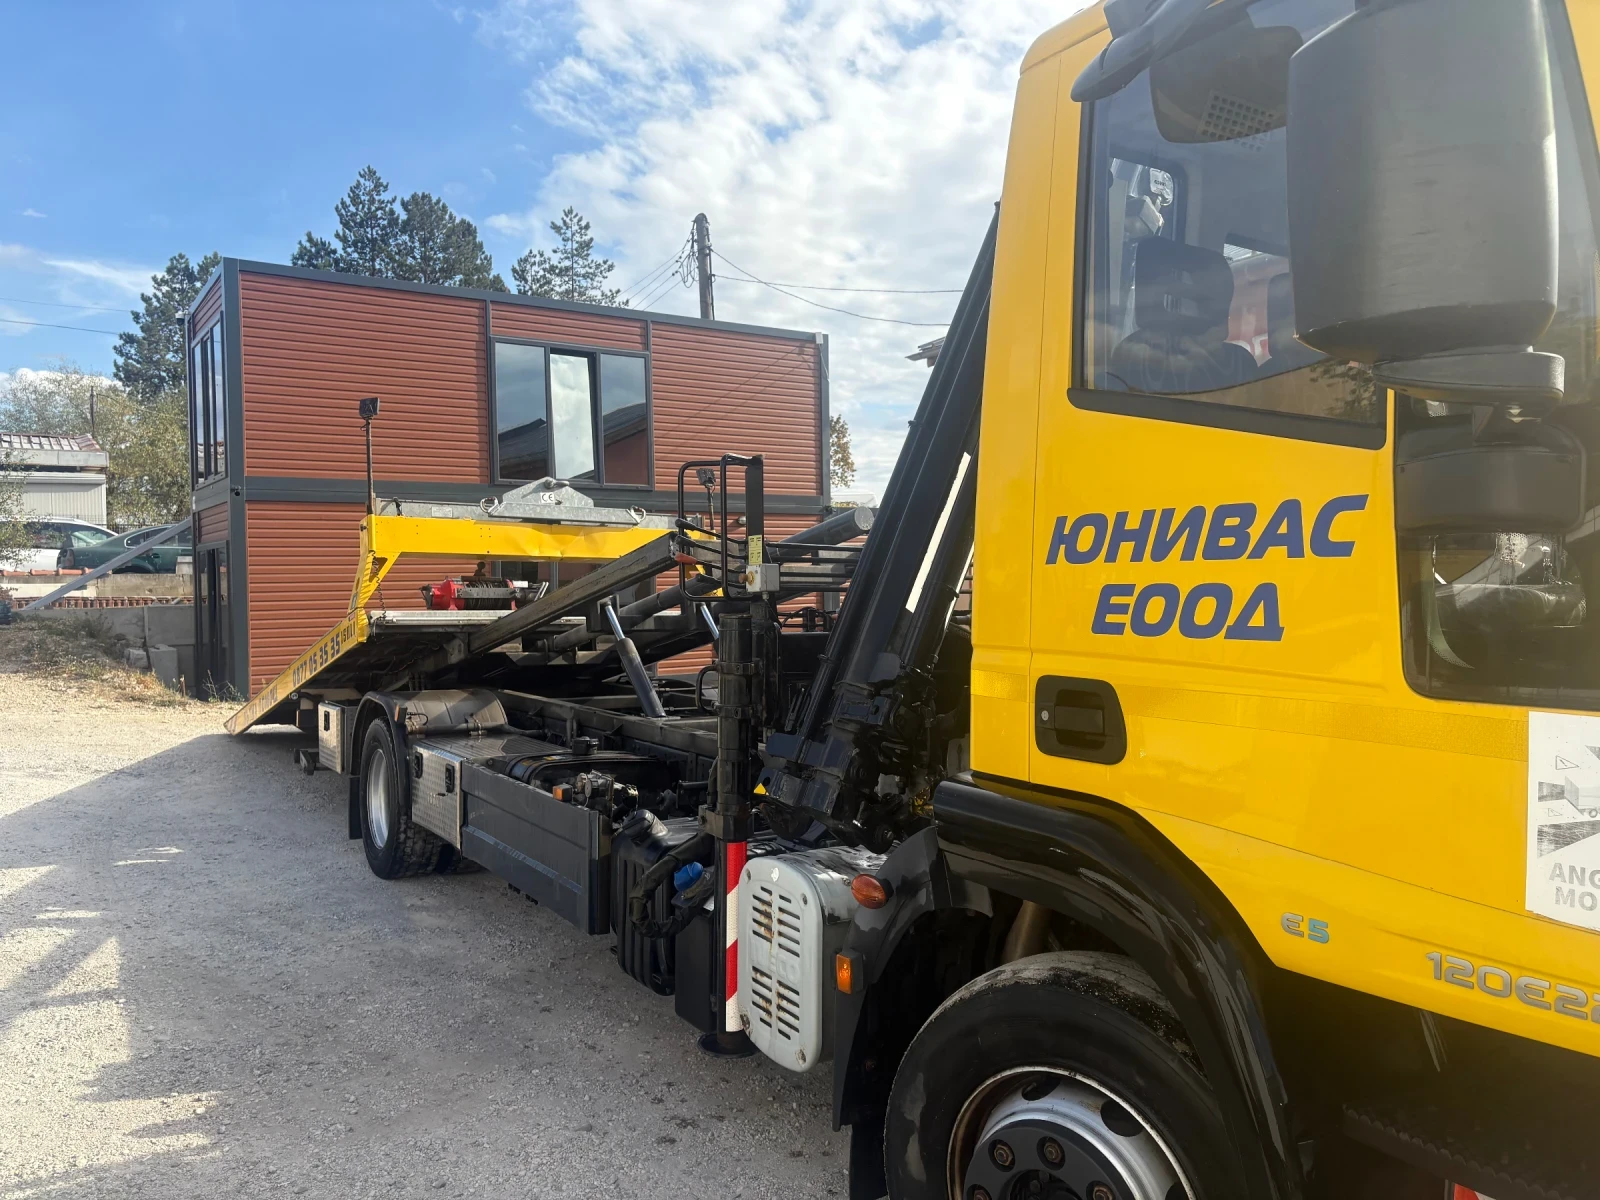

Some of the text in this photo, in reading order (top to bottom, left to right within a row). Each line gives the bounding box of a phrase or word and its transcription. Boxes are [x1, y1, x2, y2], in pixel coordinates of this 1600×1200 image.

[1045, 494, 1370, 565] ЮНИВАС
[1091, 582, 1285, 642] ЕООД
[319, 641, 329, 667] 35
[330, 632, 340, 658] 35
[1554, 887, 1598, 911] MO
[1281, 912, 1330, 944] E5
